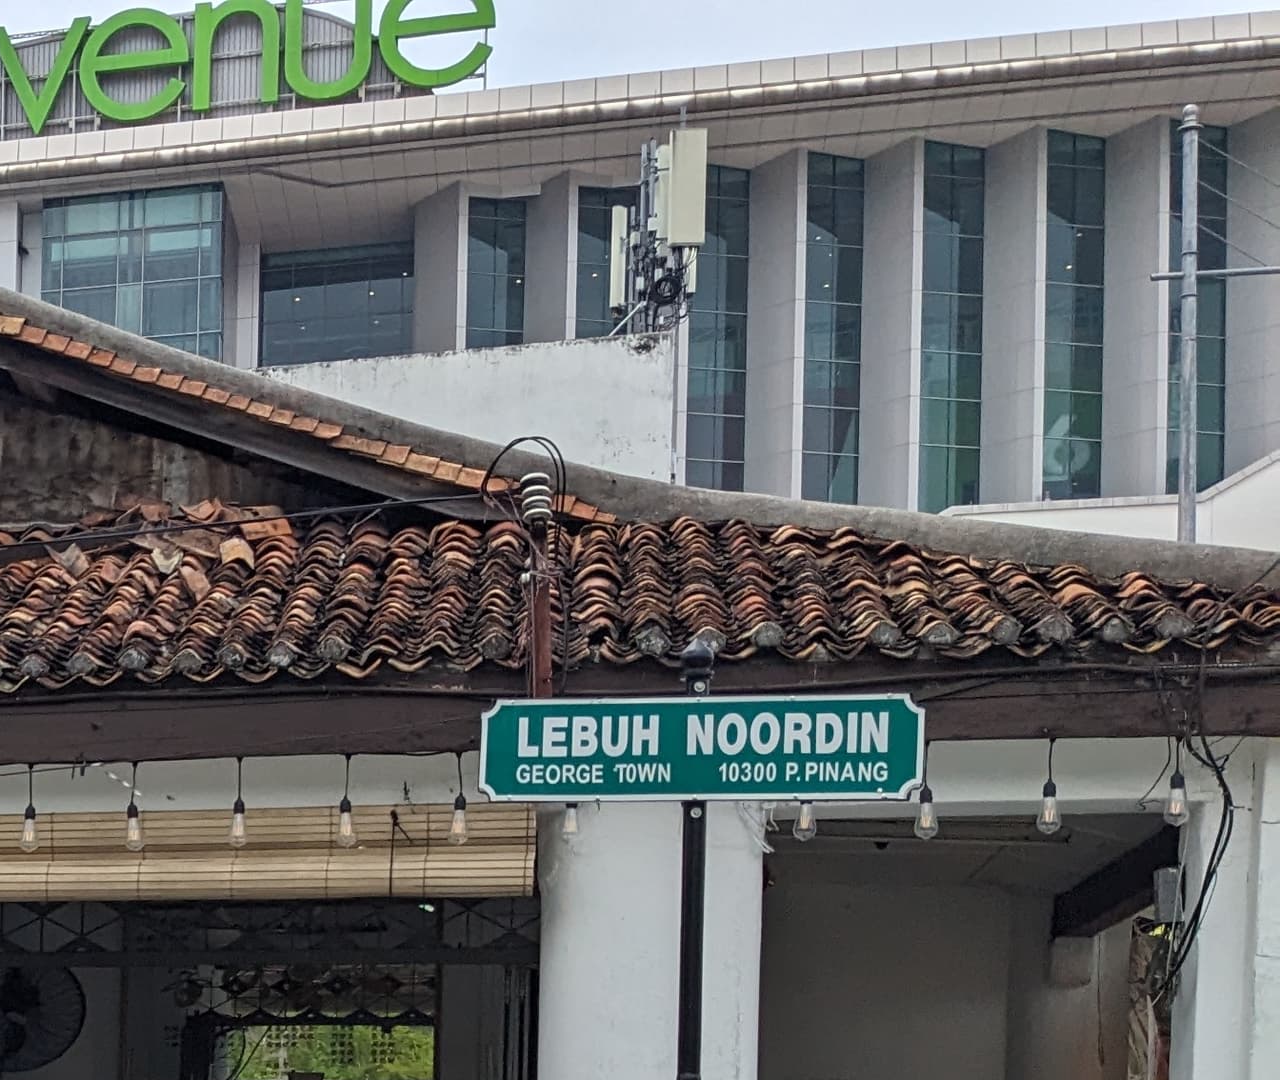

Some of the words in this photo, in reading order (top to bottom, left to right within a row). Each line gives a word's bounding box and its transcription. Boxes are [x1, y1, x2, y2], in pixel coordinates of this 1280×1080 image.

[517, 714, 660, 758] LEBUH
[686, 711, 890, 757] NOORDIN
[516, 764, 604, 784] GEORGE
[615, 762, 671, 784] TOWN
[718, 762, 777, 784] 10300
